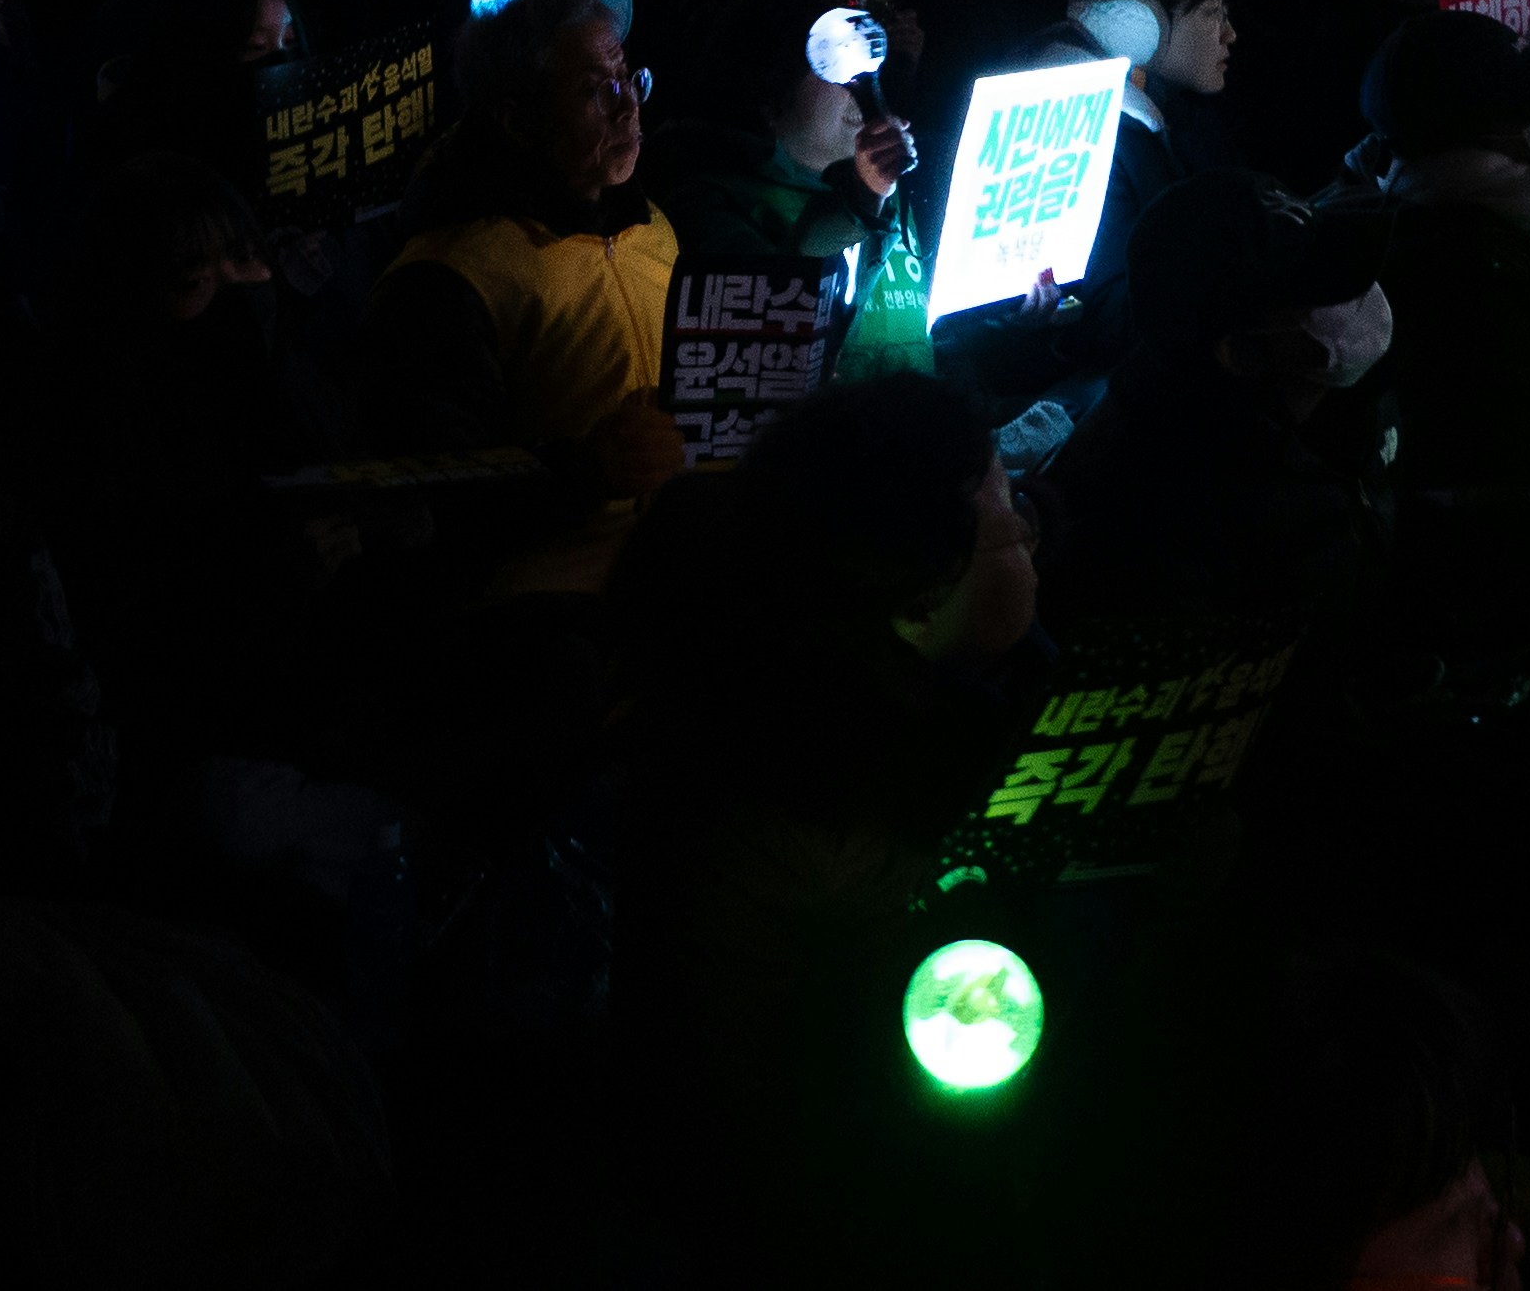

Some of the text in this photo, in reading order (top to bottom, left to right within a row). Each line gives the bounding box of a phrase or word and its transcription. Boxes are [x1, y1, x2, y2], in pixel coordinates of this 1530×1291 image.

[266, 41, 435, 143] 내란수괴 윤석열
[977, 87, 1114, 175] 시민에게
[265, 79, 436, 198] 즉각 탄핵!
[972, 150, 1091, 240] 권력을!
[673, 407, 782, 471] 구속
[1031, 675, 1191, 738] 내란수괴
[983, 736, 1140, 828] 즉각
